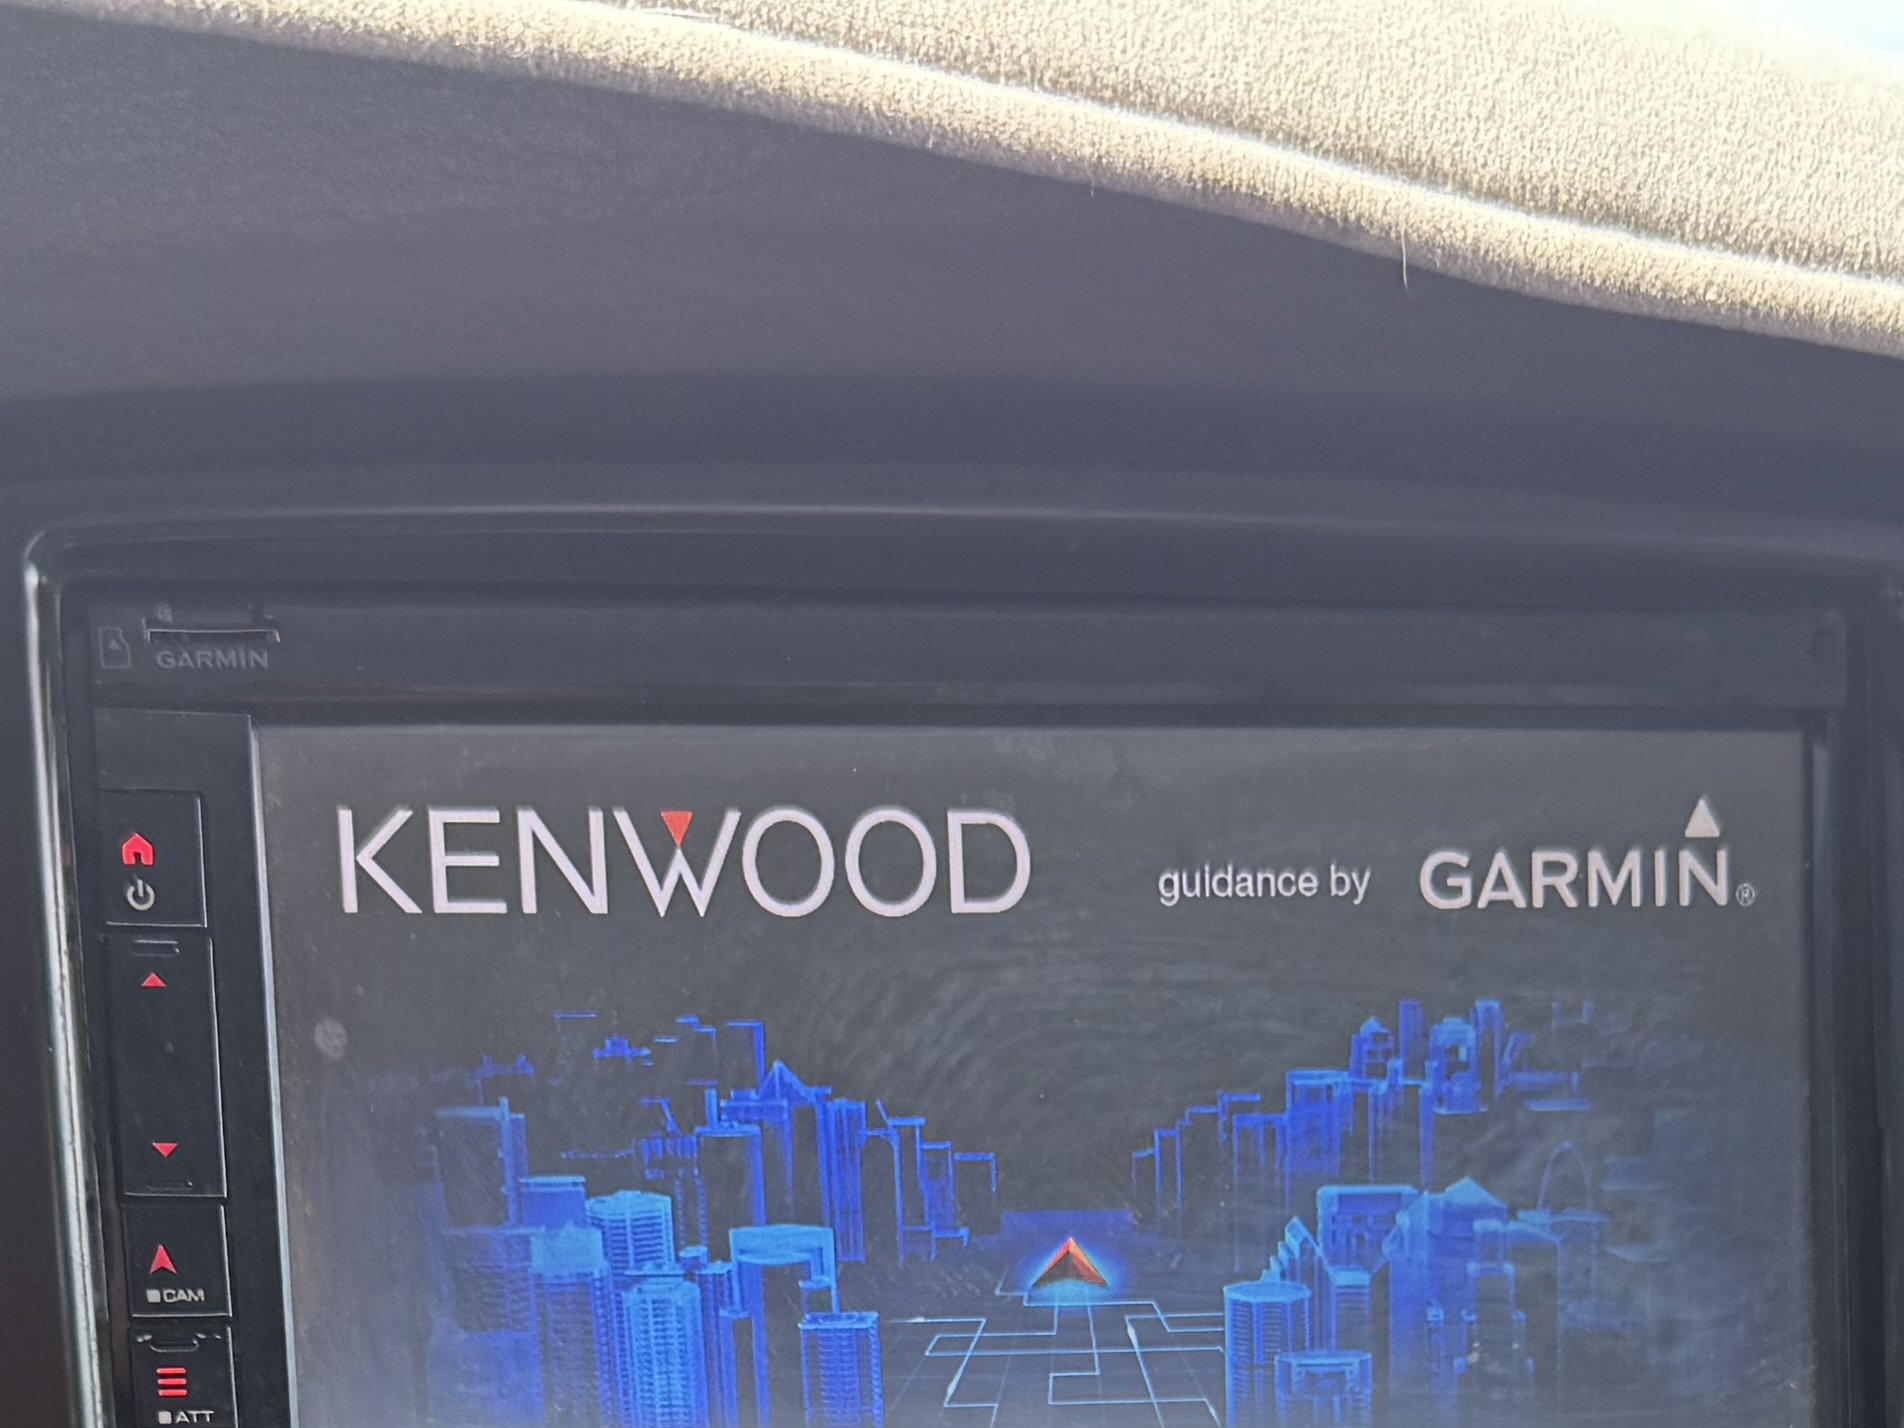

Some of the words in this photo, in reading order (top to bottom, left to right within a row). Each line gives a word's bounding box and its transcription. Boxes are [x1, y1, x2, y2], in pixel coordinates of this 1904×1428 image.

[156, 650, 269, 670] GARMIN
[335, 805, 1031, 918] KENWOOD
[1157, 860, 1319, 908] guidance
[1329, 861, 1372, 905] by
[162, 1288, 206, 1303] CAM
[175, 1410, 215, 1425] ATT
